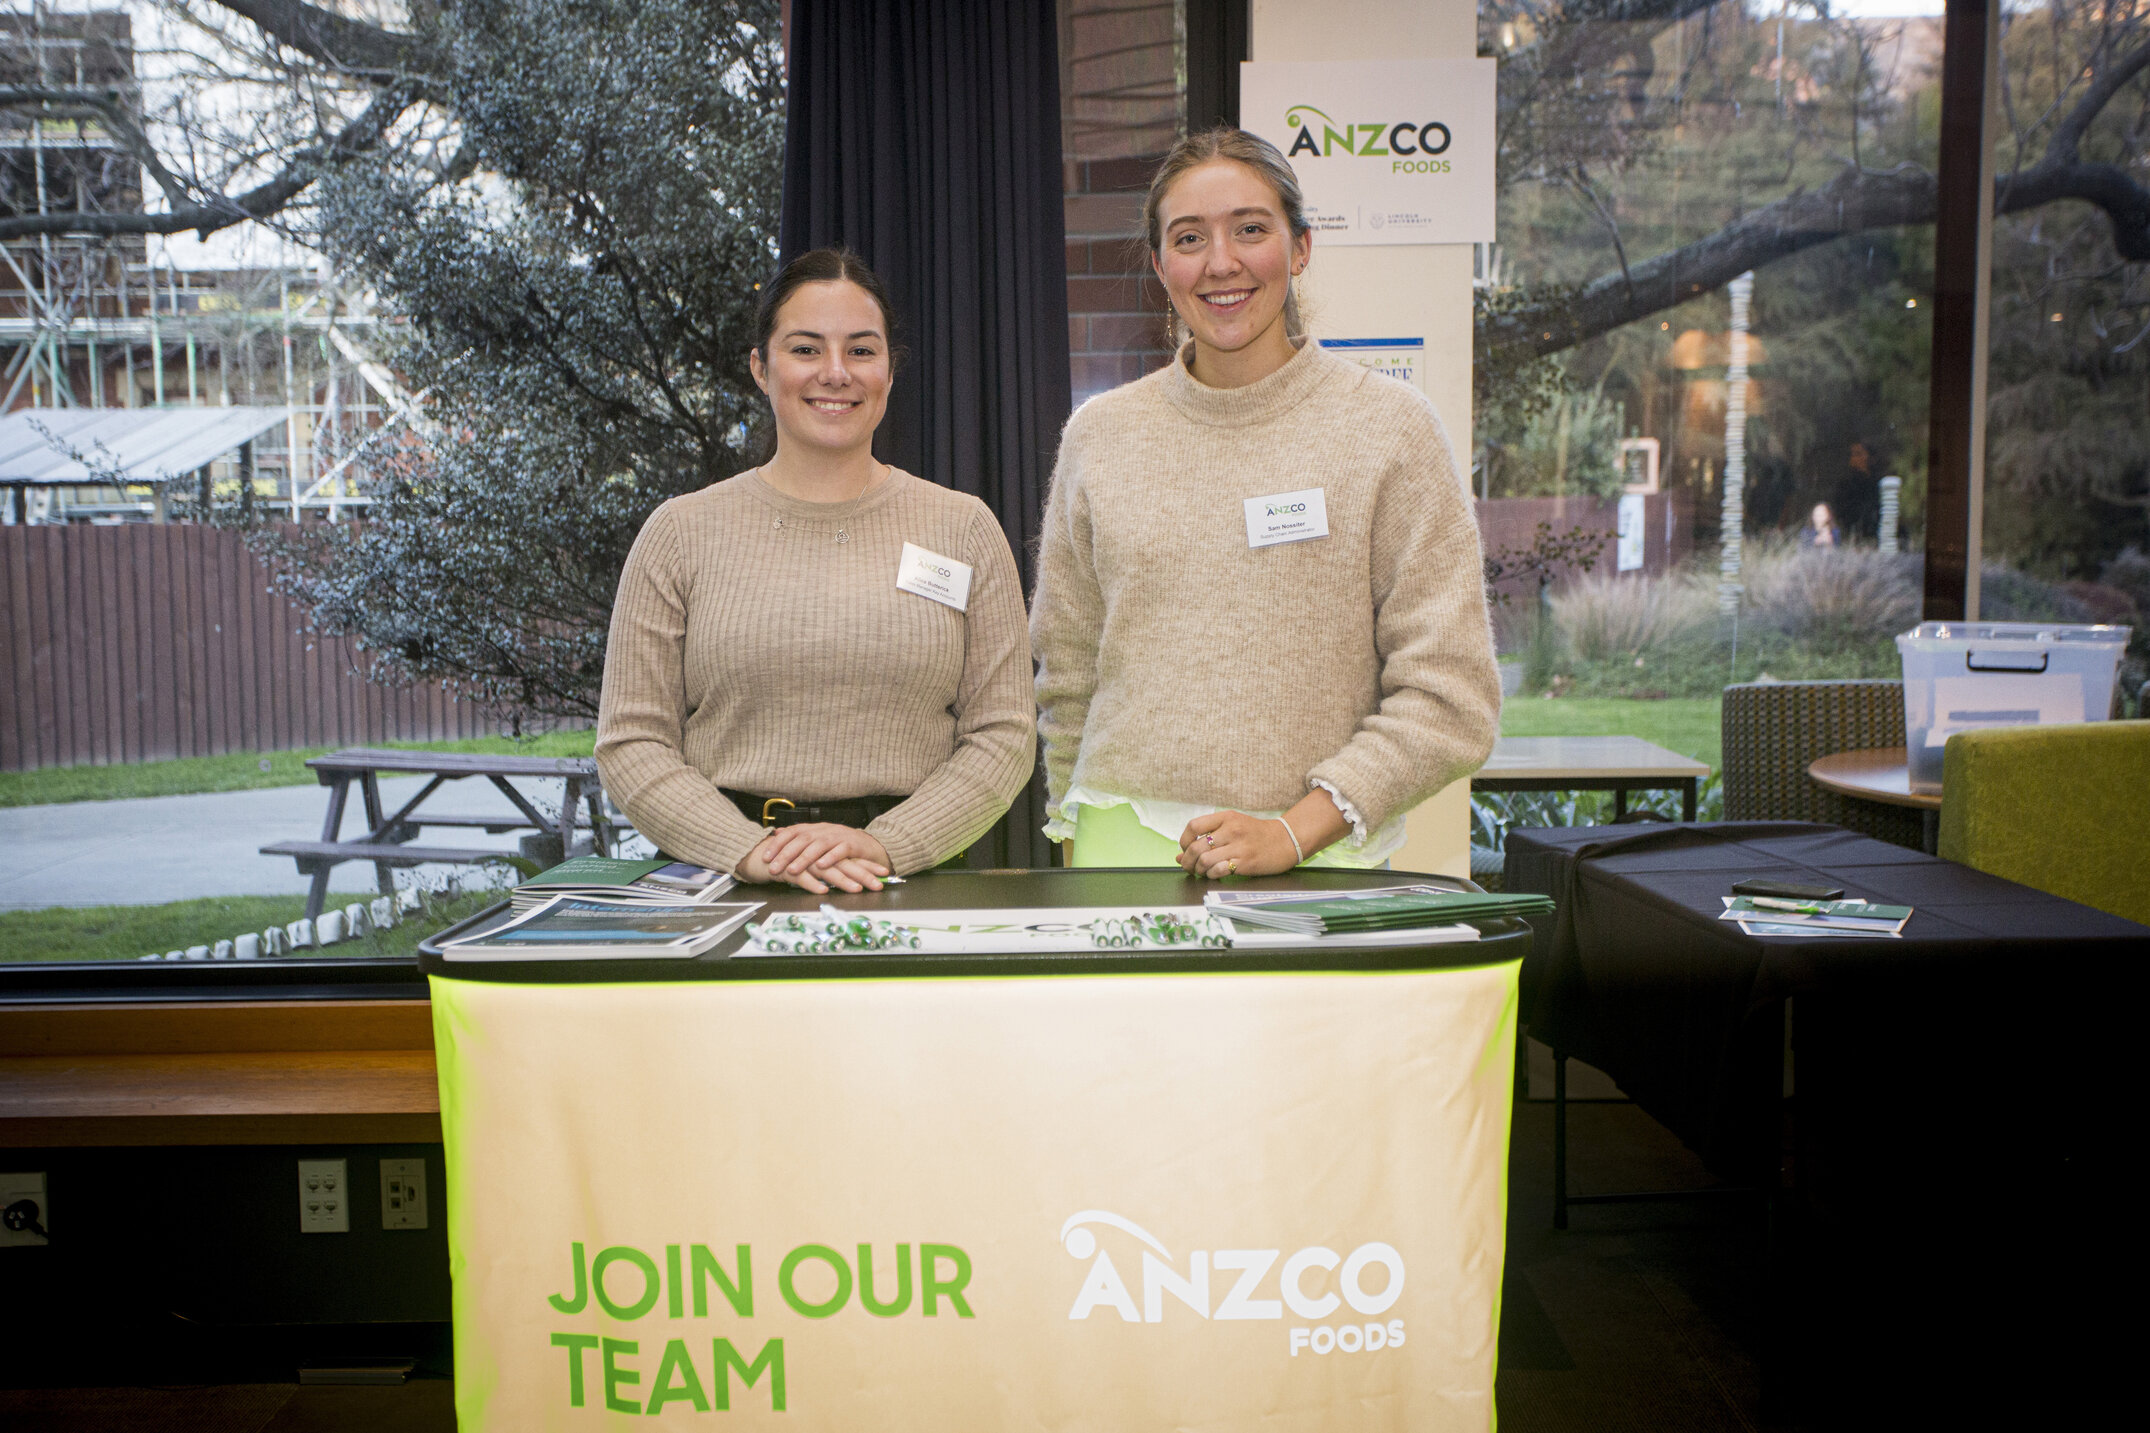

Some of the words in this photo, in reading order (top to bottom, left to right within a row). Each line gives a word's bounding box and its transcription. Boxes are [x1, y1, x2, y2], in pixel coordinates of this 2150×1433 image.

[1288, 122, 1451, 157] ANZCO
[1392, 160, 1451, 174] FOODS
[1266, 503, 1306, 516] ANZCO
[547, 1242, 754, 1321] JOIN
[778, 1243, 976, 1319] OUR
[1068, 1241, 1405, 1323] ANZCO
[1290, 1319, 1406, 1357] FOODS
[550, 1332, 786, 1416] TEAM
